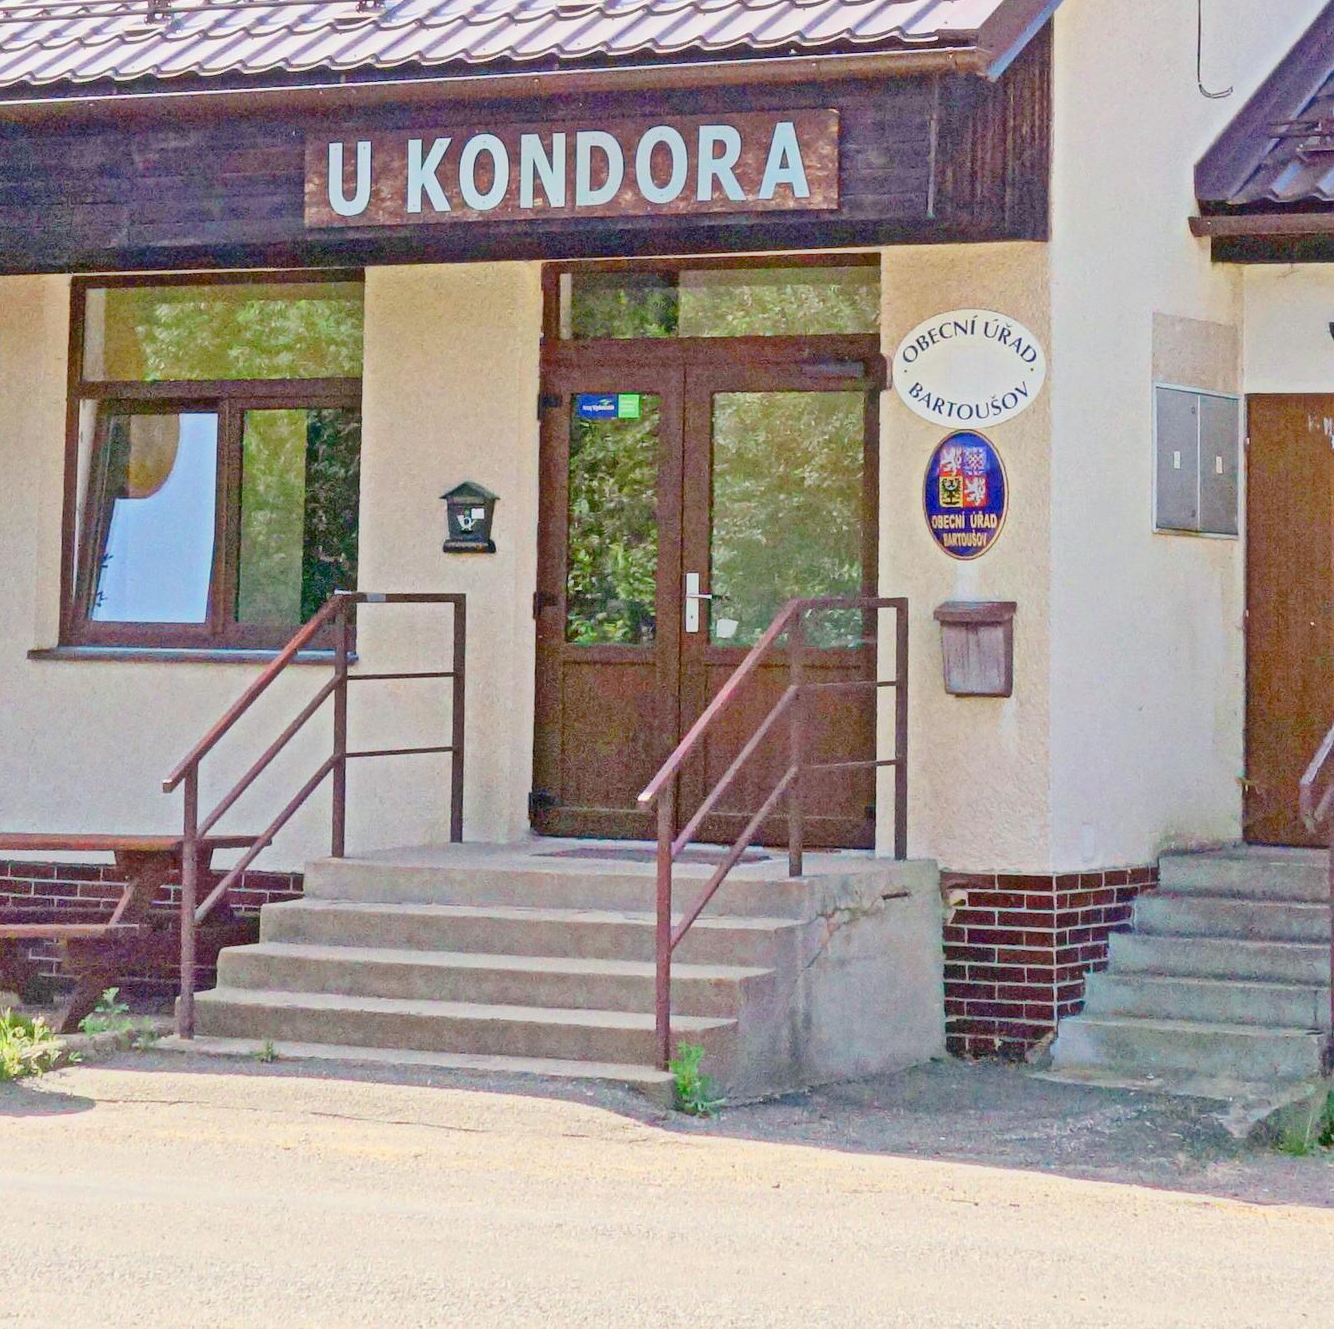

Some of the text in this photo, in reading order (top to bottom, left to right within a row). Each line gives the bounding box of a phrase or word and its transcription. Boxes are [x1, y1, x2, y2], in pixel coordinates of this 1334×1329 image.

[327, 121, 811, 217] U KONDORA
[902, 314, 1037, 363] OBECNÍ ÚŘAD
[908, 381, 1029, 420] BARTOUŠOV
[931, 511, 998, 529] OBECNÍ ÚŘAD
[943, 530, 987, 547] BARTOUŠOV
